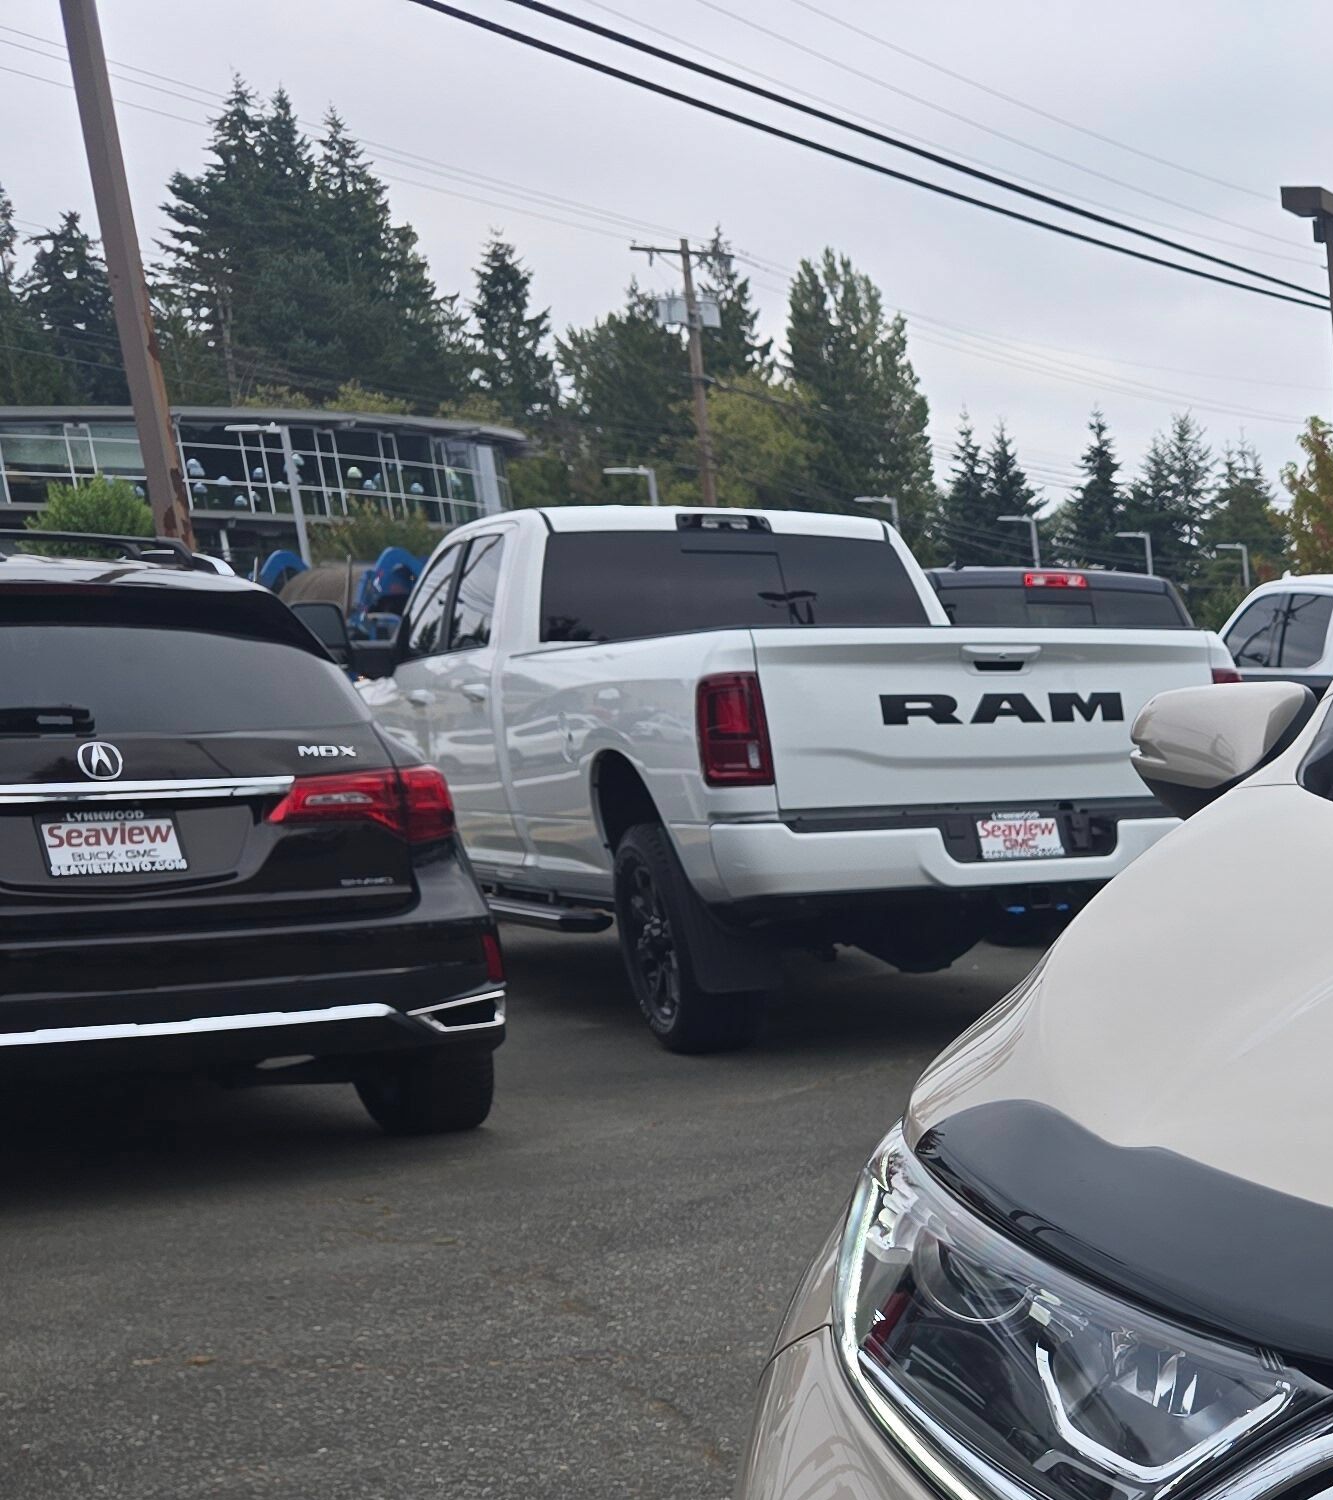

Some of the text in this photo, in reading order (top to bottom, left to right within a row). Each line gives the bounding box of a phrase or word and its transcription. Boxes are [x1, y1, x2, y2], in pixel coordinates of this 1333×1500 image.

[879, 692, 1125, 725] RAM
[297, 745, 357, 757] MDX
[66, 810, 145, 822] LYNNWOOD
[47, 822, 173, 849] Seaview
[979, 819, 1055, 838] Seaview
